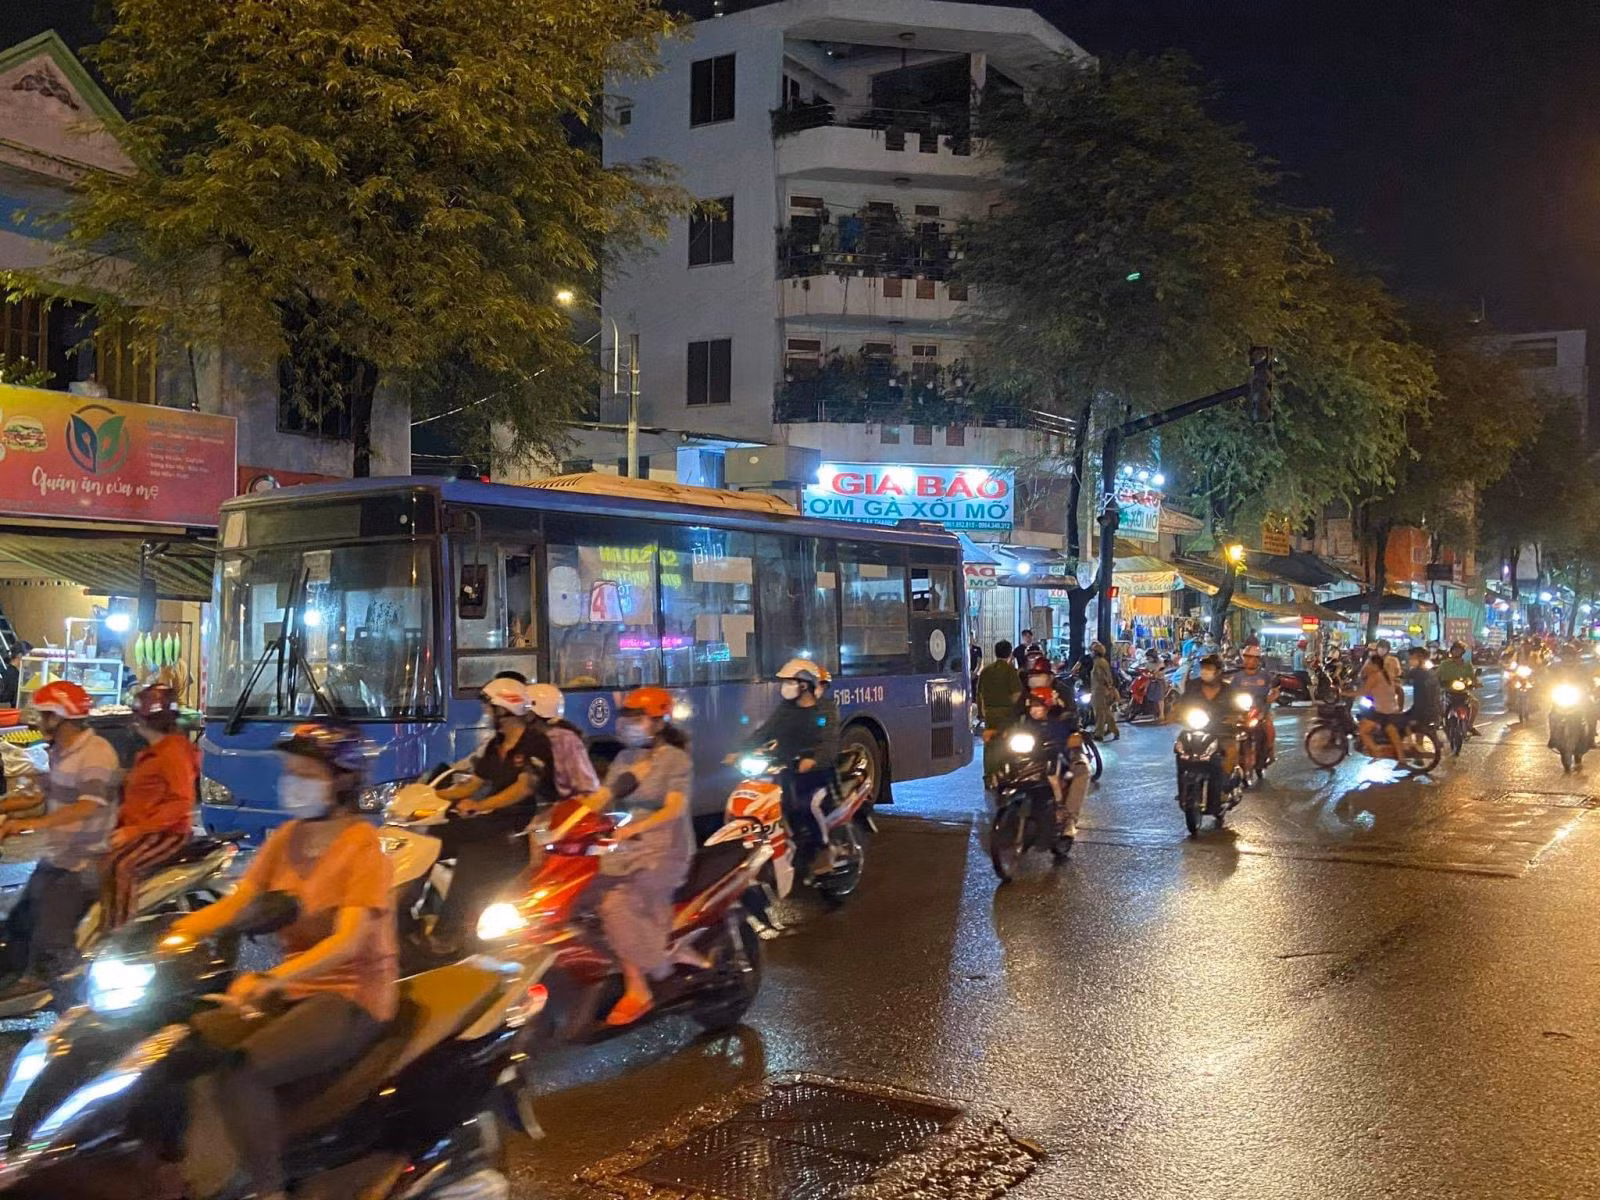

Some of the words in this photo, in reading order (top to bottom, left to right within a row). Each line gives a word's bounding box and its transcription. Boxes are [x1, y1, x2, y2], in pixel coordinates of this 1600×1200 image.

[31, 466, 76, 496] Quán
[81, 476, 103, 496] ăn
[136, 484, 159, 500] mẹ
[832, 472, 904, 496] GIA
[917, 471, 1009, 499] BẢO
[863, 496, 903, 517] GÀ
[966, 500, 1009, 519] MỠ
[833, 685, 885, 705] 51B-114.10
